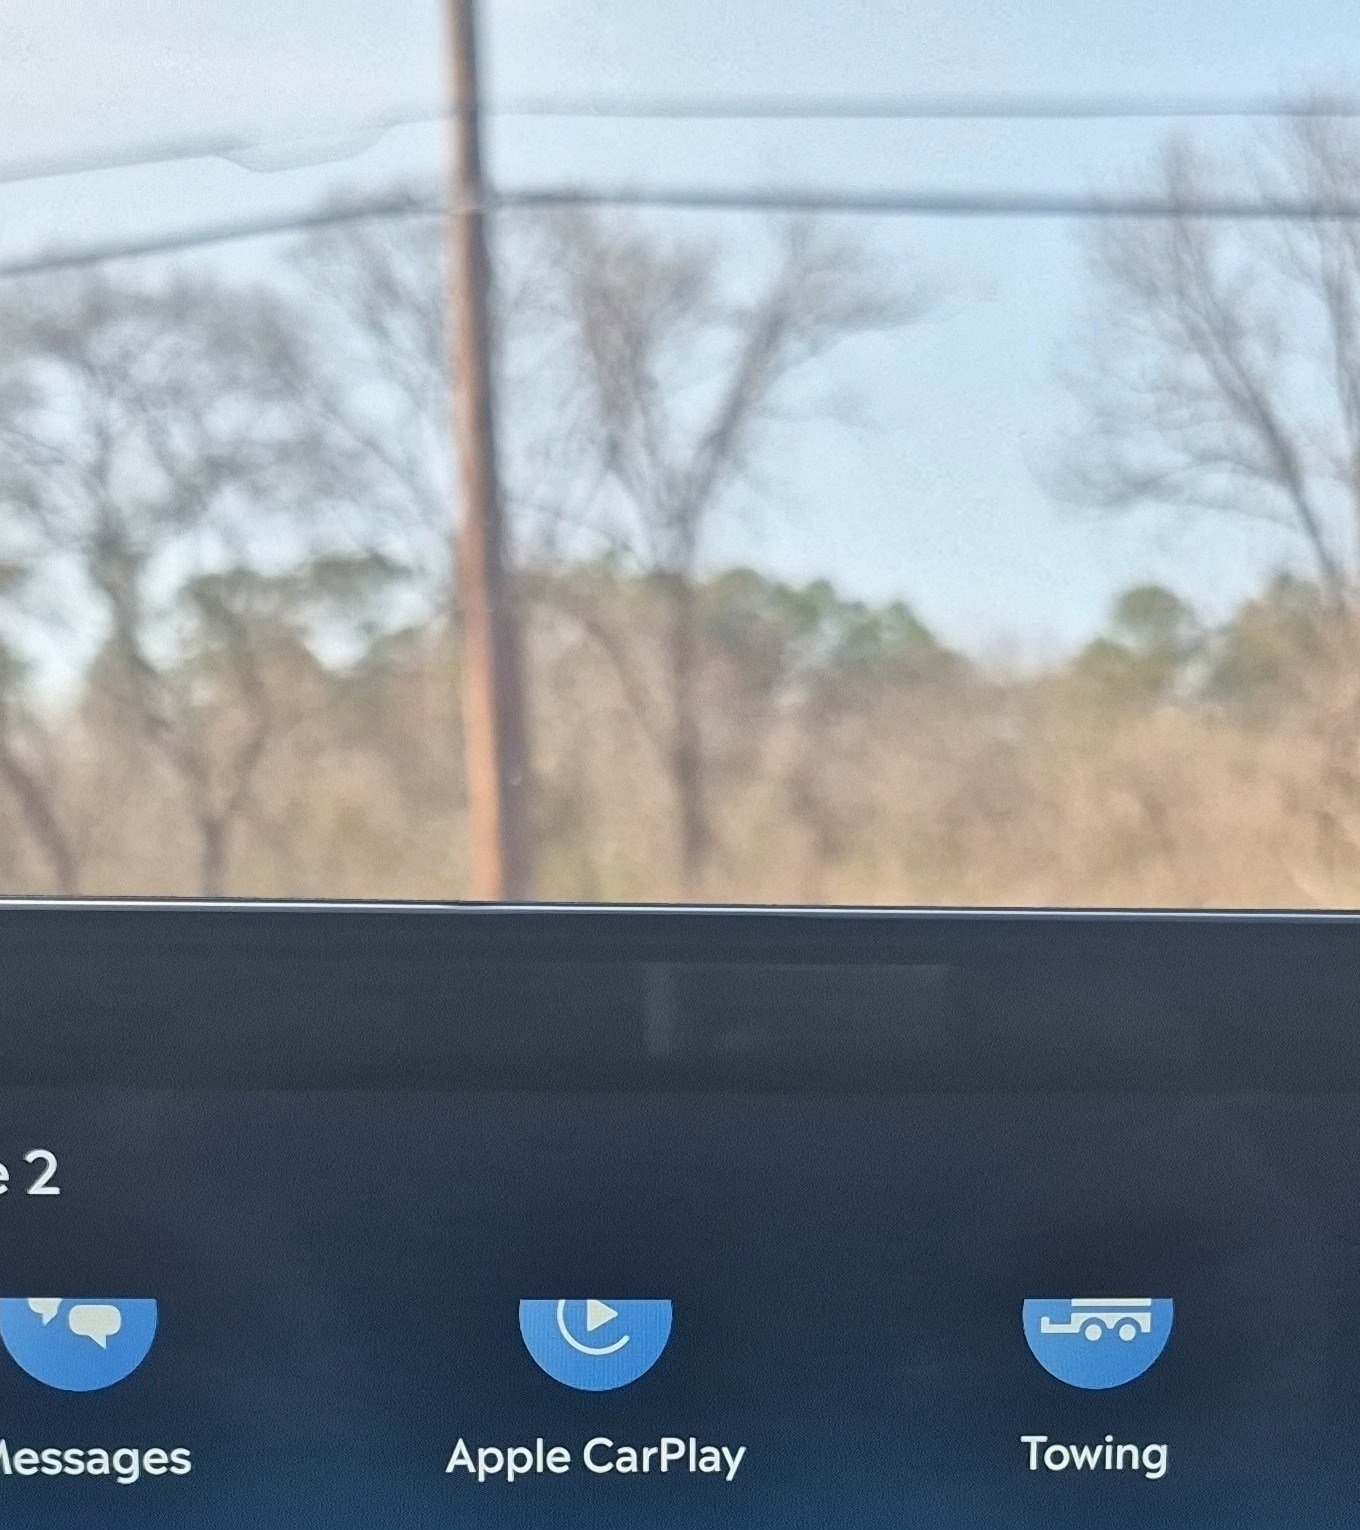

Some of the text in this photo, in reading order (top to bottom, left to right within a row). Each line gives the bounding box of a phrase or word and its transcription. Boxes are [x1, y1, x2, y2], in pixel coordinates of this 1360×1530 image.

[24, 1148, 60, 1195] 2
[445, 1436, 746, 1483] Apple CarPlay
[1020, 1434, 1168, 1480] Towing
